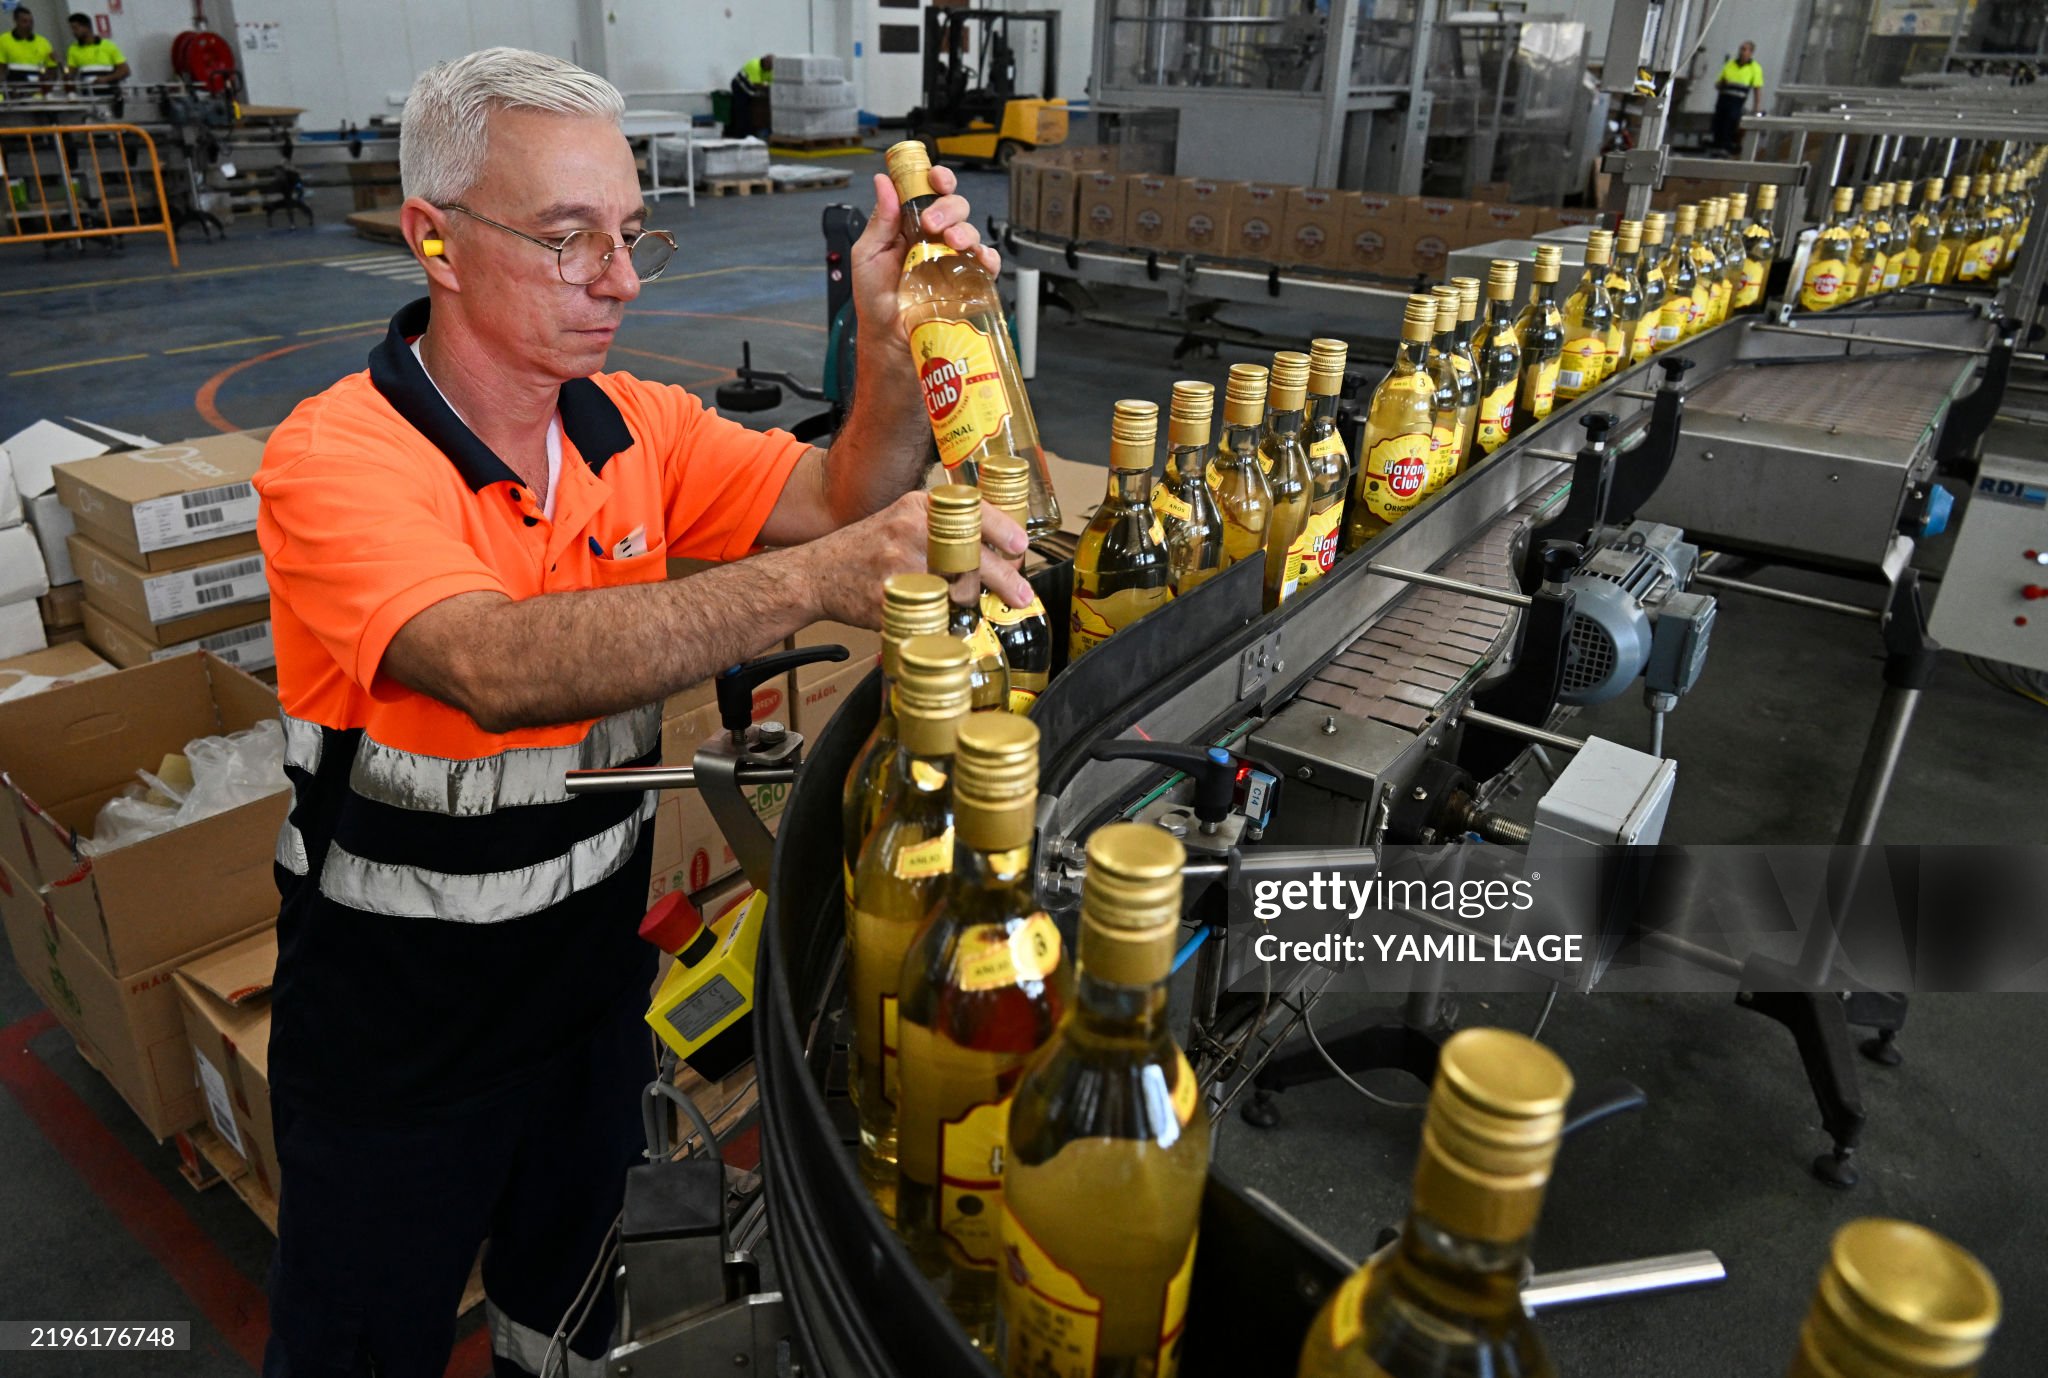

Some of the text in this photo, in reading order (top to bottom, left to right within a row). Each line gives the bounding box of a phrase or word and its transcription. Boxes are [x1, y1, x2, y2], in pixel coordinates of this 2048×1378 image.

[922, 358, 970, 395] avana
[1419, 378, 1426, 388] 3
[926, 386, 958, 415] Club
[1392, 476, 1420, 490] Club
[1979, 477, 2025, 497] RDI
[805, 684, 838, 706] FRÁGIL
[1251, 787, 1262, 807] C14
